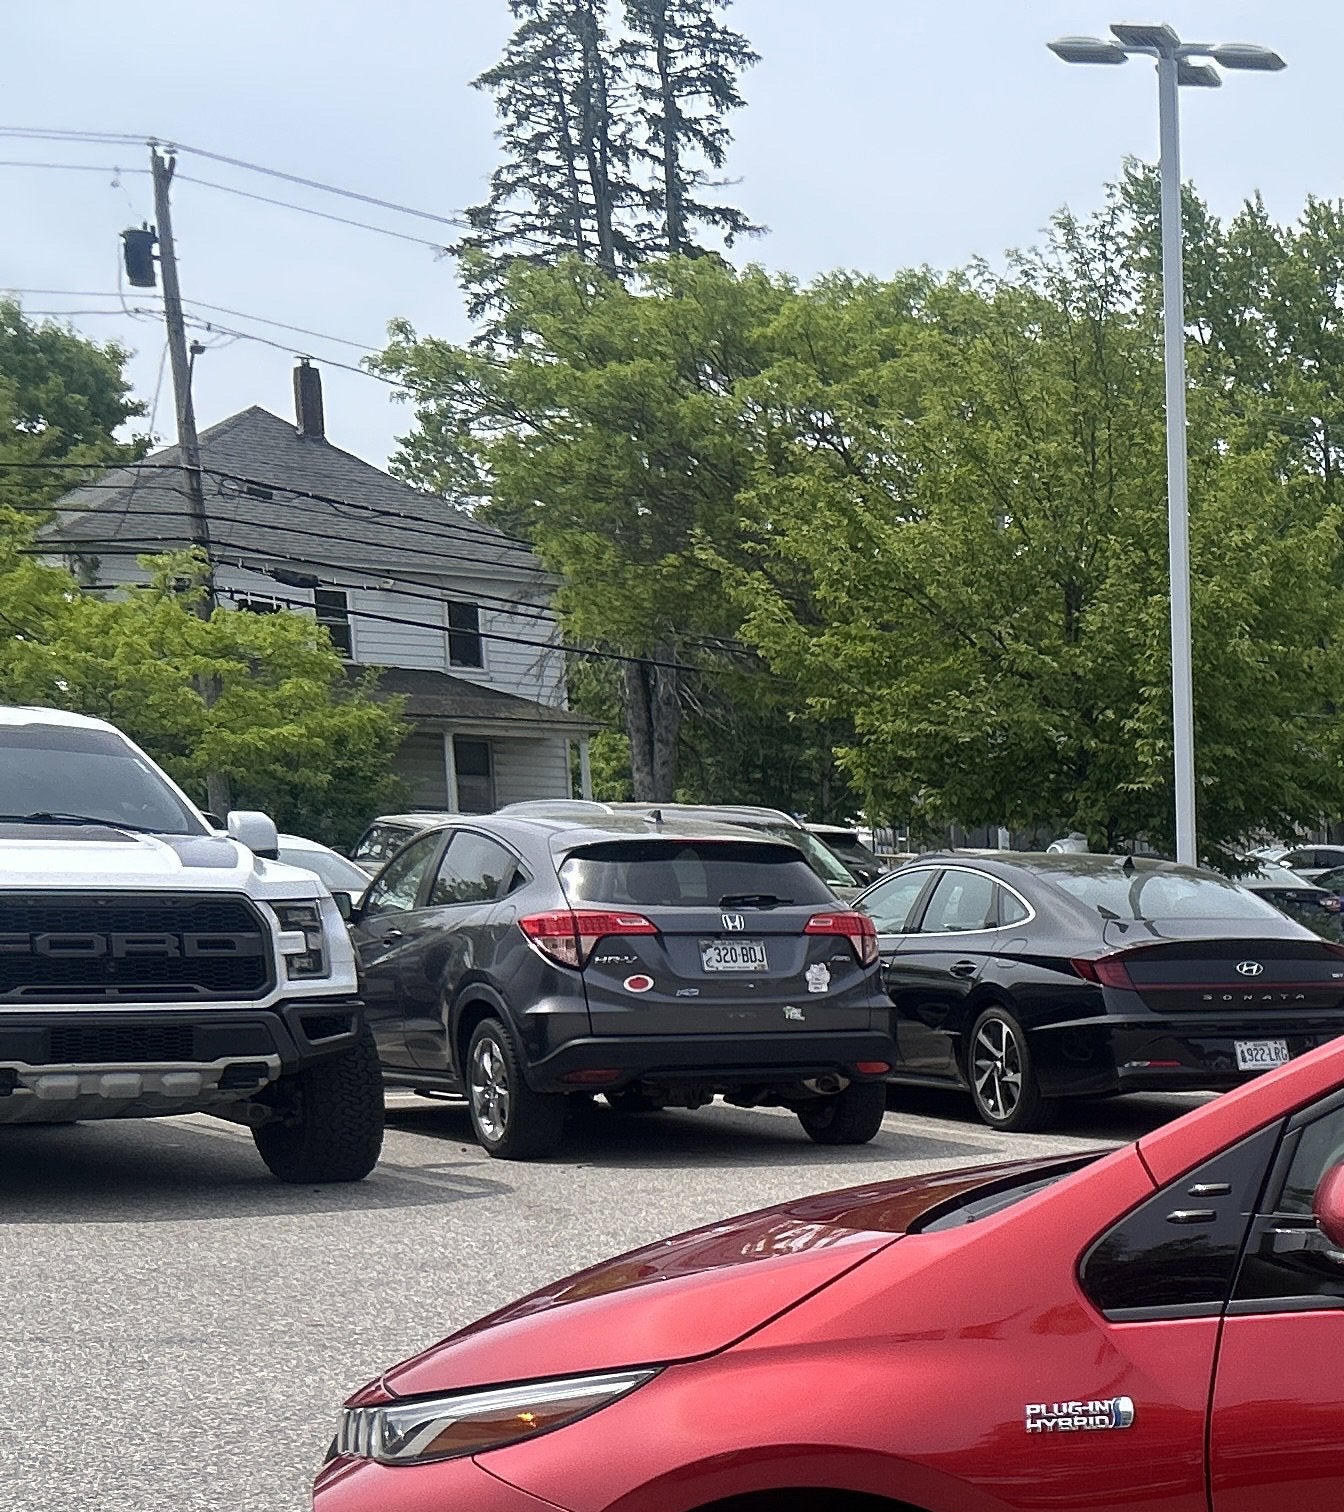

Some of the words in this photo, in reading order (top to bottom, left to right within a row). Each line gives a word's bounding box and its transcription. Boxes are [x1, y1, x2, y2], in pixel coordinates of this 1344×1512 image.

[1203, 993, 1305, 1001] SONATA
[1025, 1399, 1114, 1417] PLUG-IN
[1026, 1415, 1114, 1434] HYBRID
